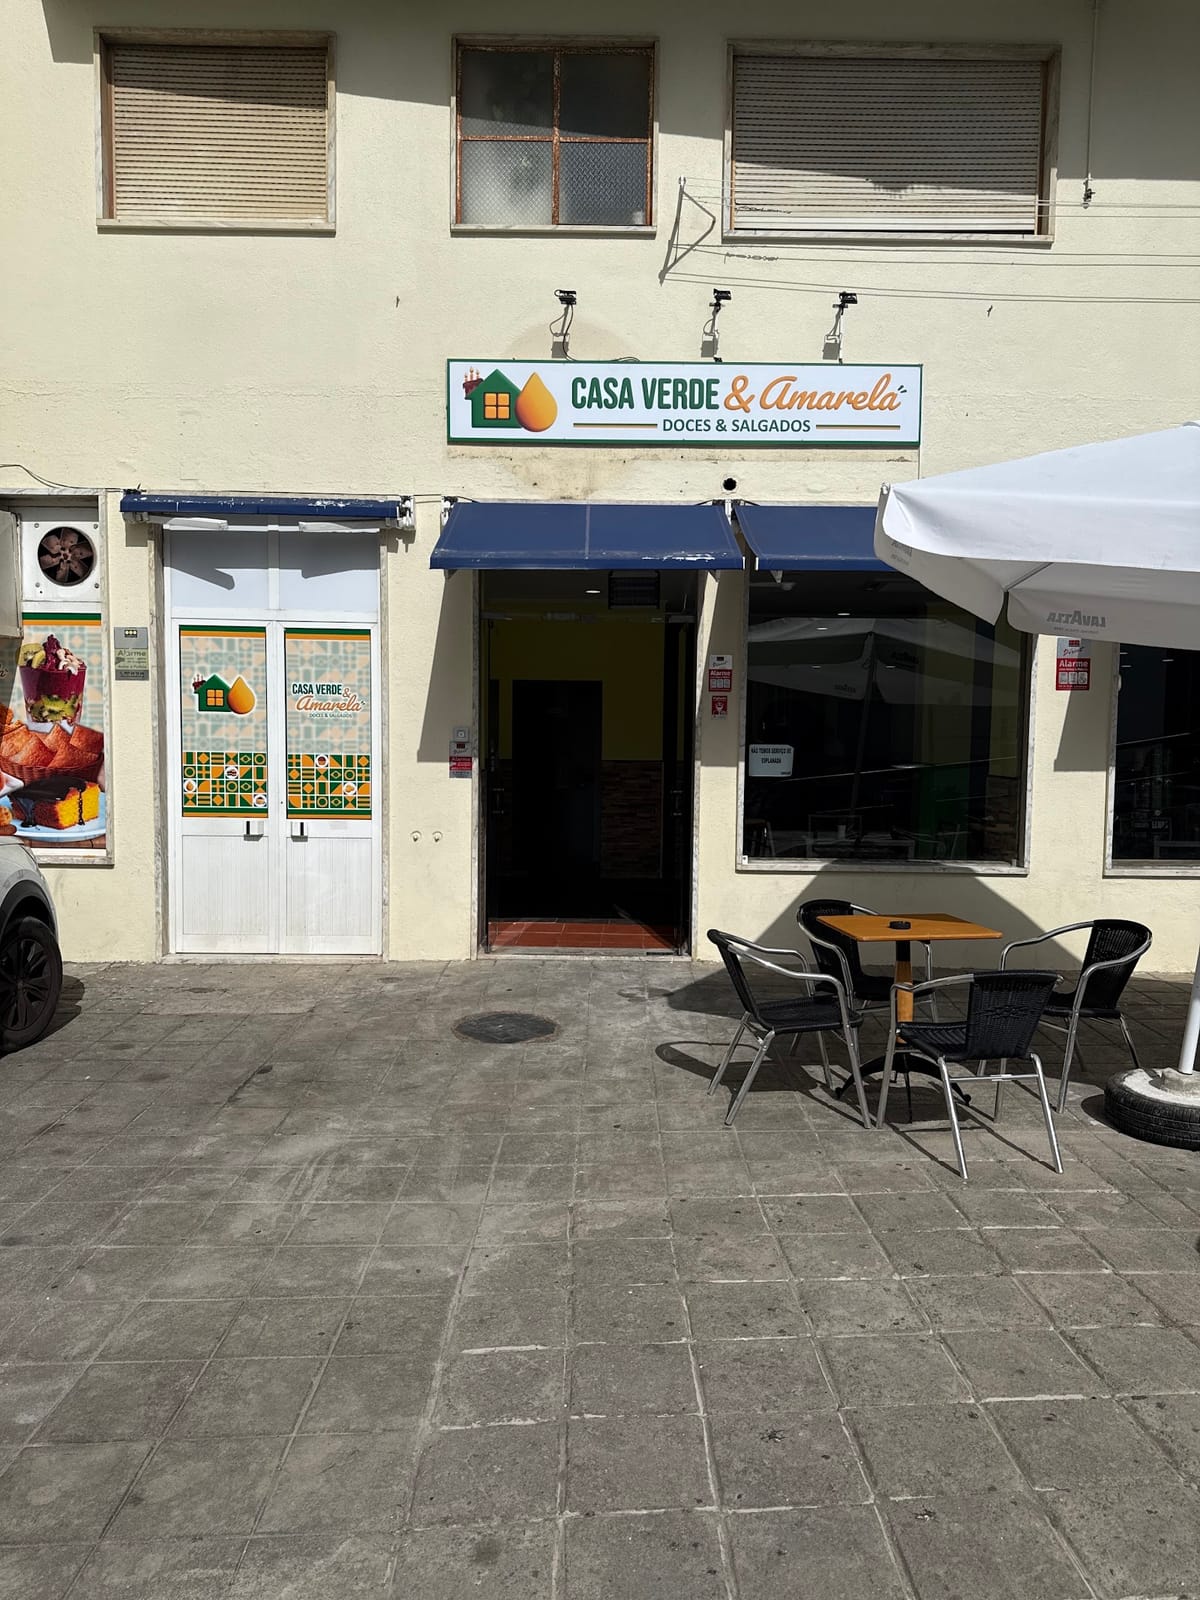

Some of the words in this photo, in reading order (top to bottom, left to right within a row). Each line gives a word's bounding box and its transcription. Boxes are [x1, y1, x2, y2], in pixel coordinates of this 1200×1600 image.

[571, 377, 635, 410] CASA
[641, 378, 721, 410] VERDE
[723, 375, 755, 413] &
[759, 373, 901, 411] Amarela
[662, 419, 711, 432] DOCES
[715, 419, 727, 432] &
[731, 419, 811, 433] SALGADOS
[1059, 659, 1089, 668] Alarme
[292, 683, 314, 695] CASA
[315, 684, 343, 695] VERDE
[297, 695, 361, 711] Amarela
